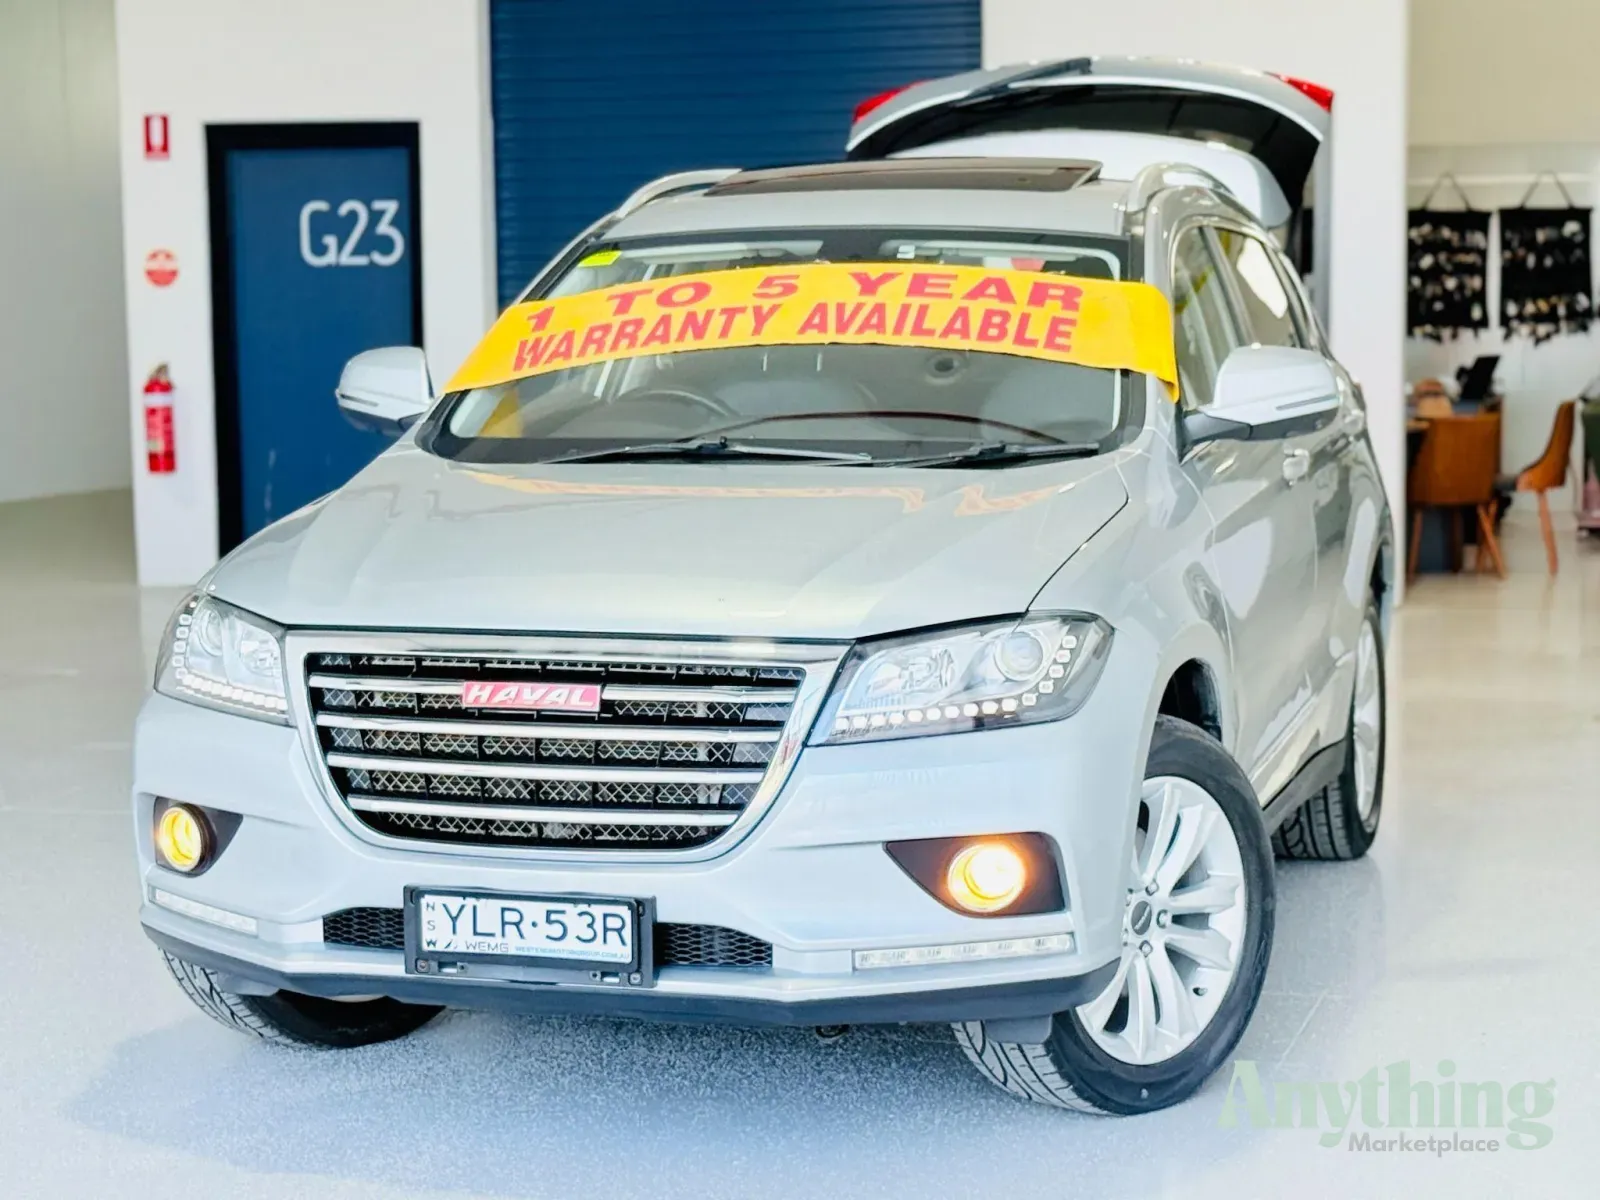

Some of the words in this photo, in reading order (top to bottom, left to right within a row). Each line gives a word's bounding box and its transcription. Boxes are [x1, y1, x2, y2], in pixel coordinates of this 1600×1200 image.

[299, 199, 405, 267] G23
[527, 306, 555, 332] 1
[607, 281, 712, 317] TO
[753, 275, 800, 299] 5
[848, 272, 1084, 312] YEAR
[512, 304, 783, 372] WARRANTY
[797, 302, 1077, 353] AVAILABLE
[466, 683, 594, 707] HAVAL
[465, 940, 509, 953] WEMG
